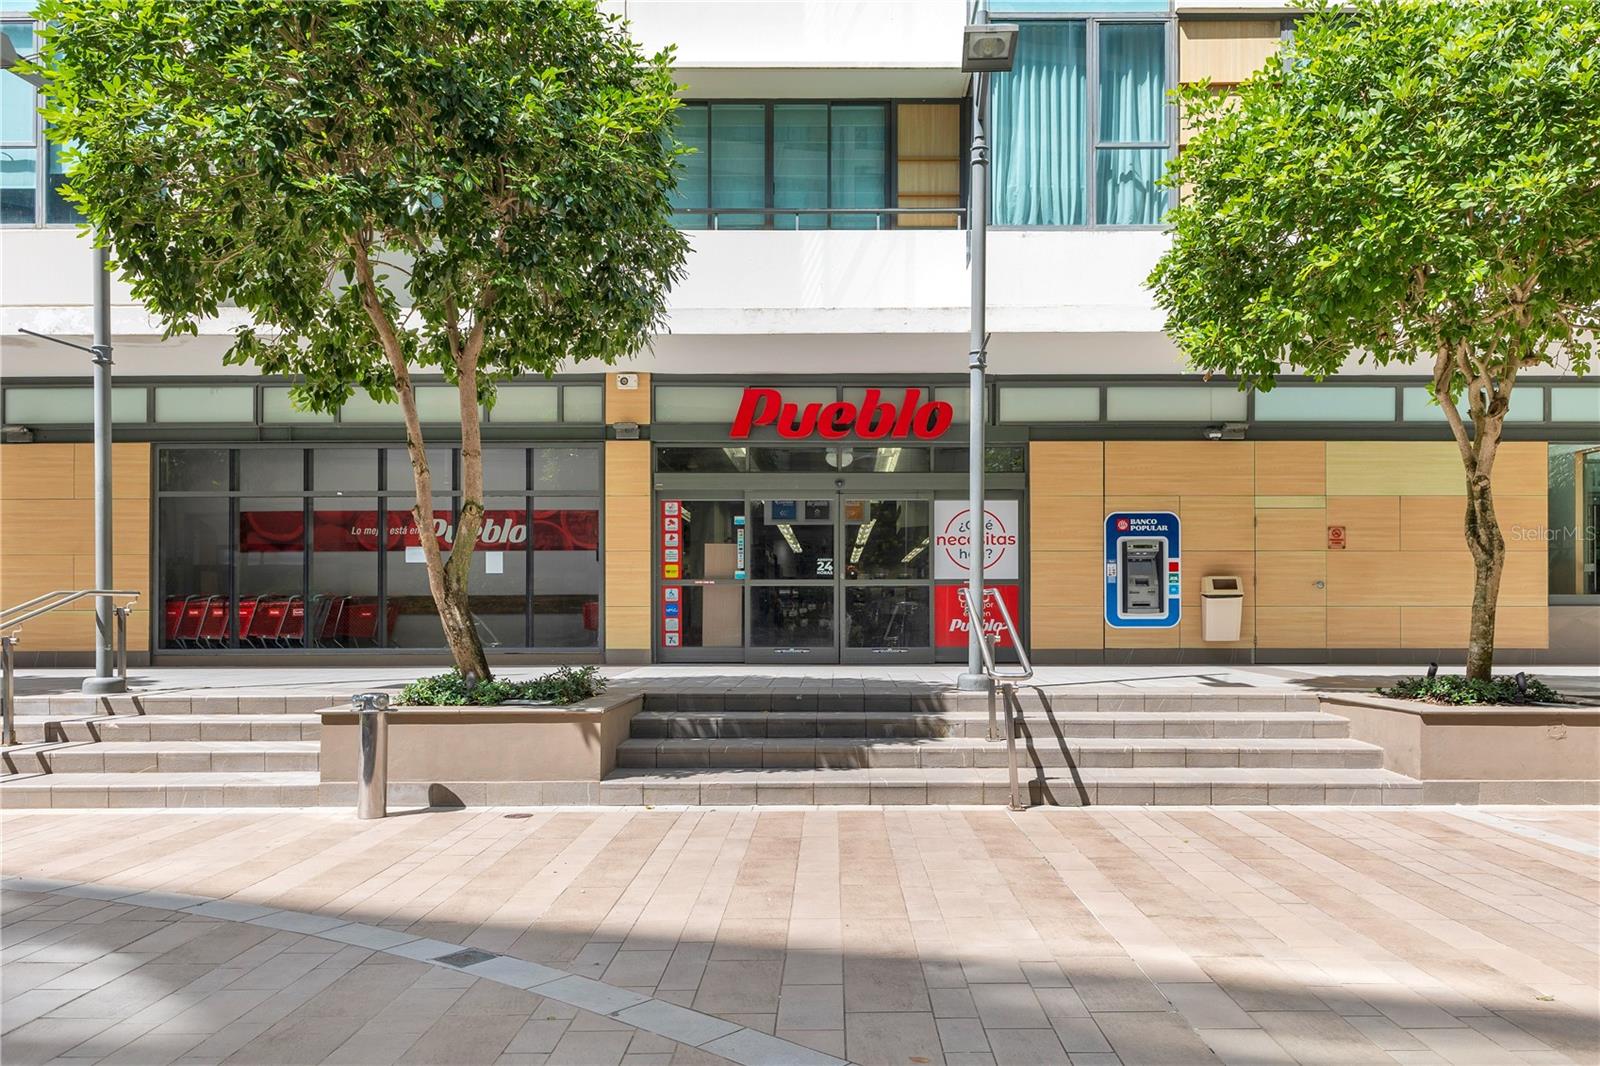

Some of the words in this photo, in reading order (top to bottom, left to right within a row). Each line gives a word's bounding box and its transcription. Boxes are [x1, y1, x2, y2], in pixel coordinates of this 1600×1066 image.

[729, 387, 953, 439] Pueblo
[351, 526, 361, 535] Lo
[363, 528, 379, 536] mej
[389, 526, 407, 535] está
[936, 532, 1016, 546] necitas
[959, 548, 993, 559] h?
[817, 561, 833, 571] 24
